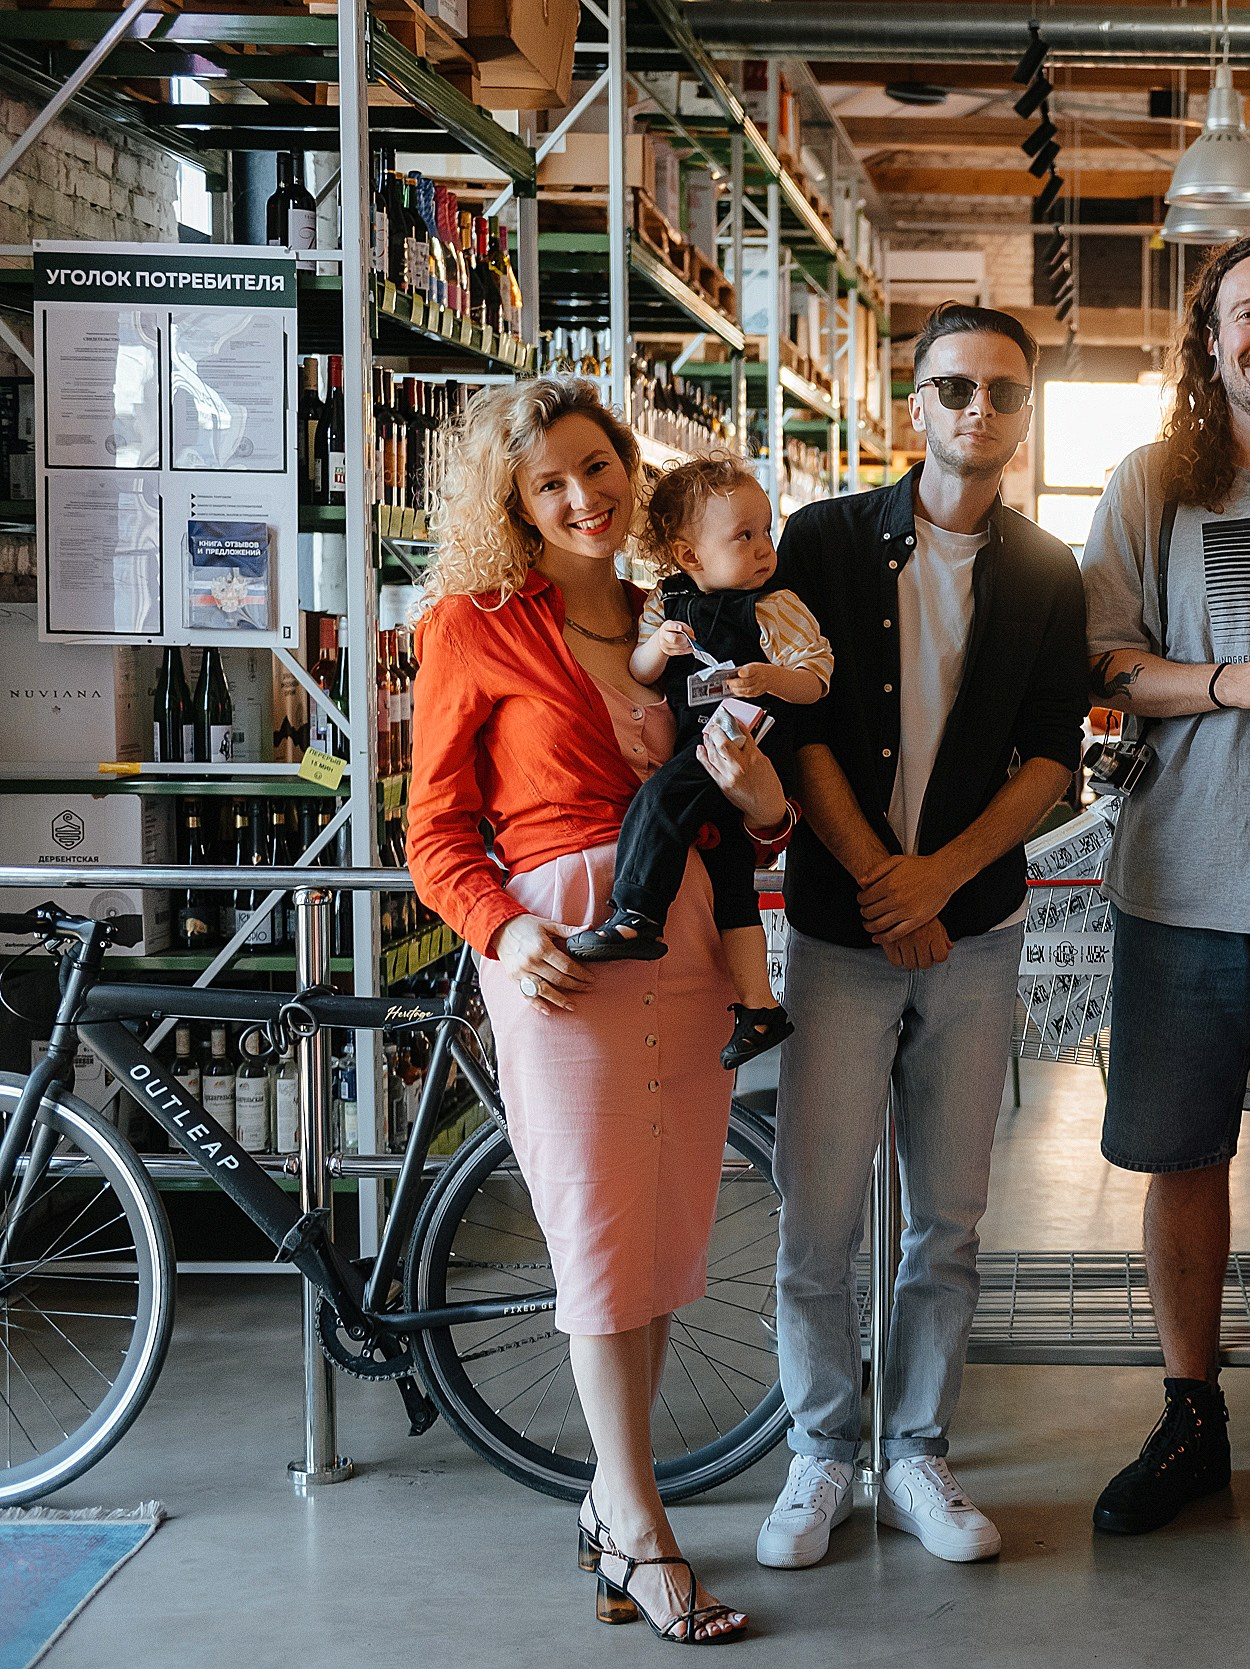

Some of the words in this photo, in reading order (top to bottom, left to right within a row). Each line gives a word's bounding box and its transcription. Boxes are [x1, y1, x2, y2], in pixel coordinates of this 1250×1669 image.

[46, 269, 131, 287] УГОЛОК
[135, 271, 285, 291] ПОТРЕБИТЕЛЯ
[198, 540, 222, 548] КНИГА
[224, 541, 260, 549] ОТЗЫВОВ
[197, 548, 203, 556] И
[205, 548, 261, 556] ПРЕДЛОЖЕНИЙ
[9, 690, 101, 698] NUVIANA
[309, 749, 342, 766] ПЕРЕРЫВ
[319, 763, 334, 773] МИН
[38, 855, 99, 863] ДЕРБЕНТСКАЯ
[384, 1005, 434, 1021] Heritage
[130, 1064, 240, 1170] OUTLEAP
[503, 1303, 536, 1315] FIXED
[541, 1301, 555, 1310] GE
